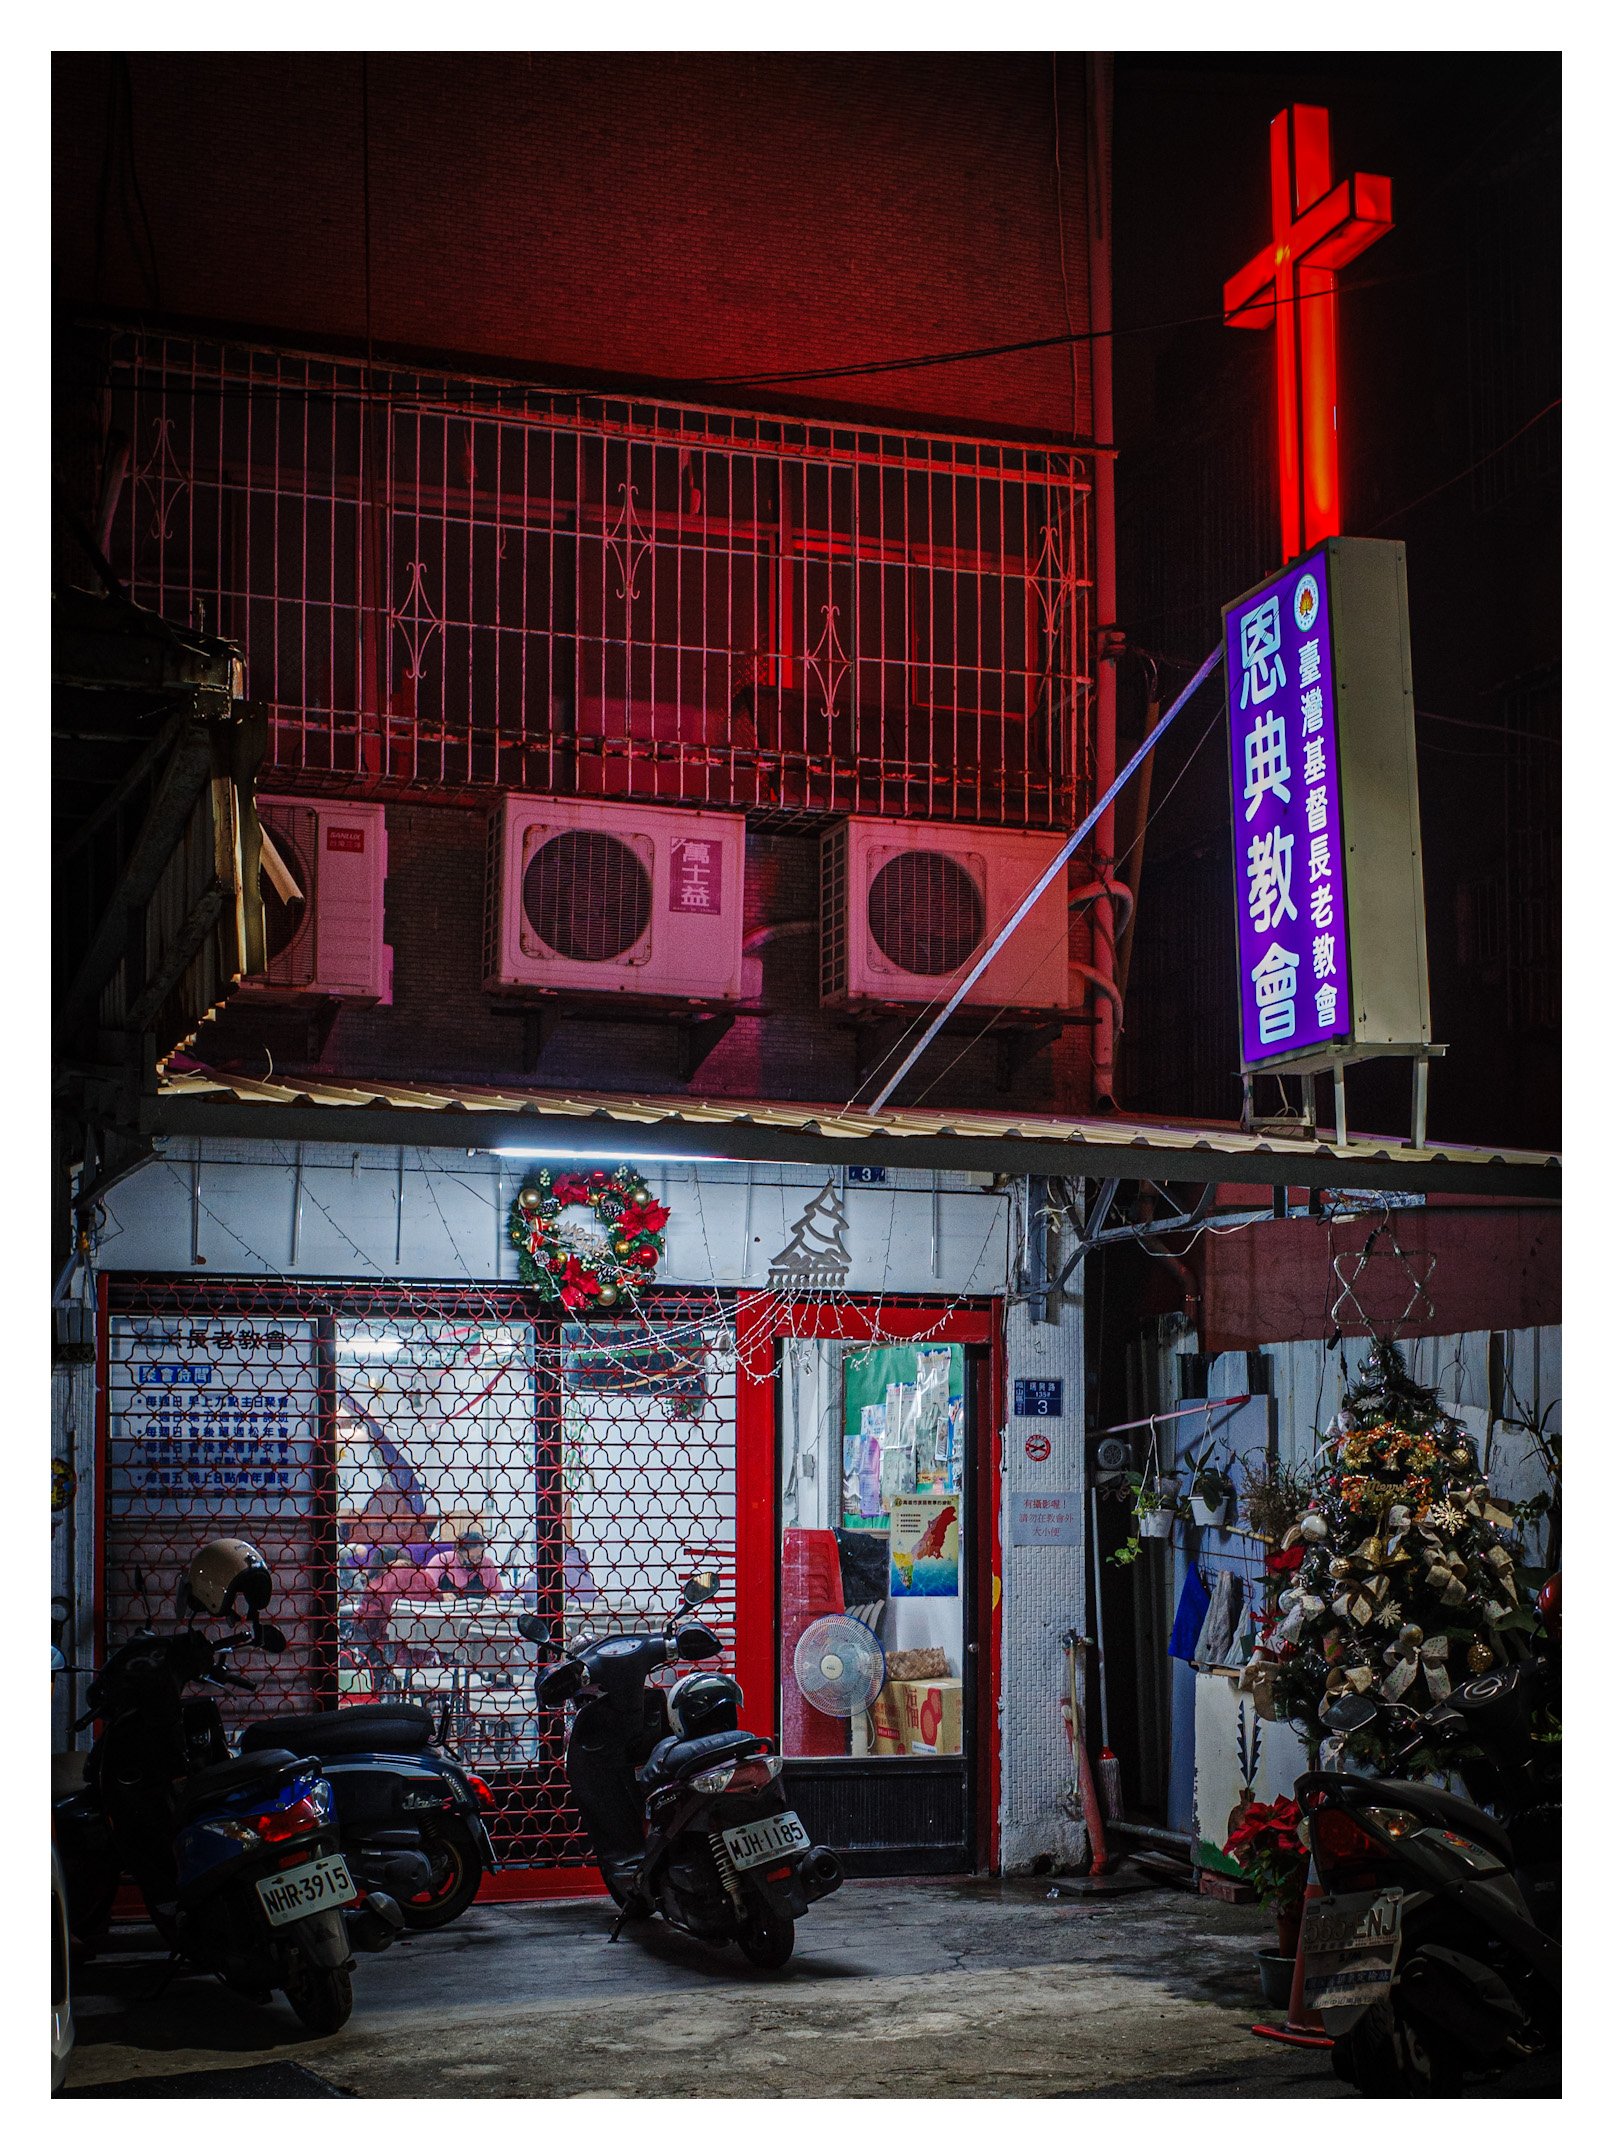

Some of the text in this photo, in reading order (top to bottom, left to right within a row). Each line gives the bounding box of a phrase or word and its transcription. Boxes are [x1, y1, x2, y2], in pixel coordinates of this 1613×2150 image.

[1240, 595, 1300, 1045] 恩典教會
[1297, 639, 1337, 1028] 臺灣基督長老教會
[681, 842, 711, 907] 萬士益
[142, 1368, 210, 1383] 聚會時間
[1037, 1400, 1048, 1415] 3
[729, 1821, 804, 1860] MJH-1185
[263, 1866, 349, 1915] NHR-3915
